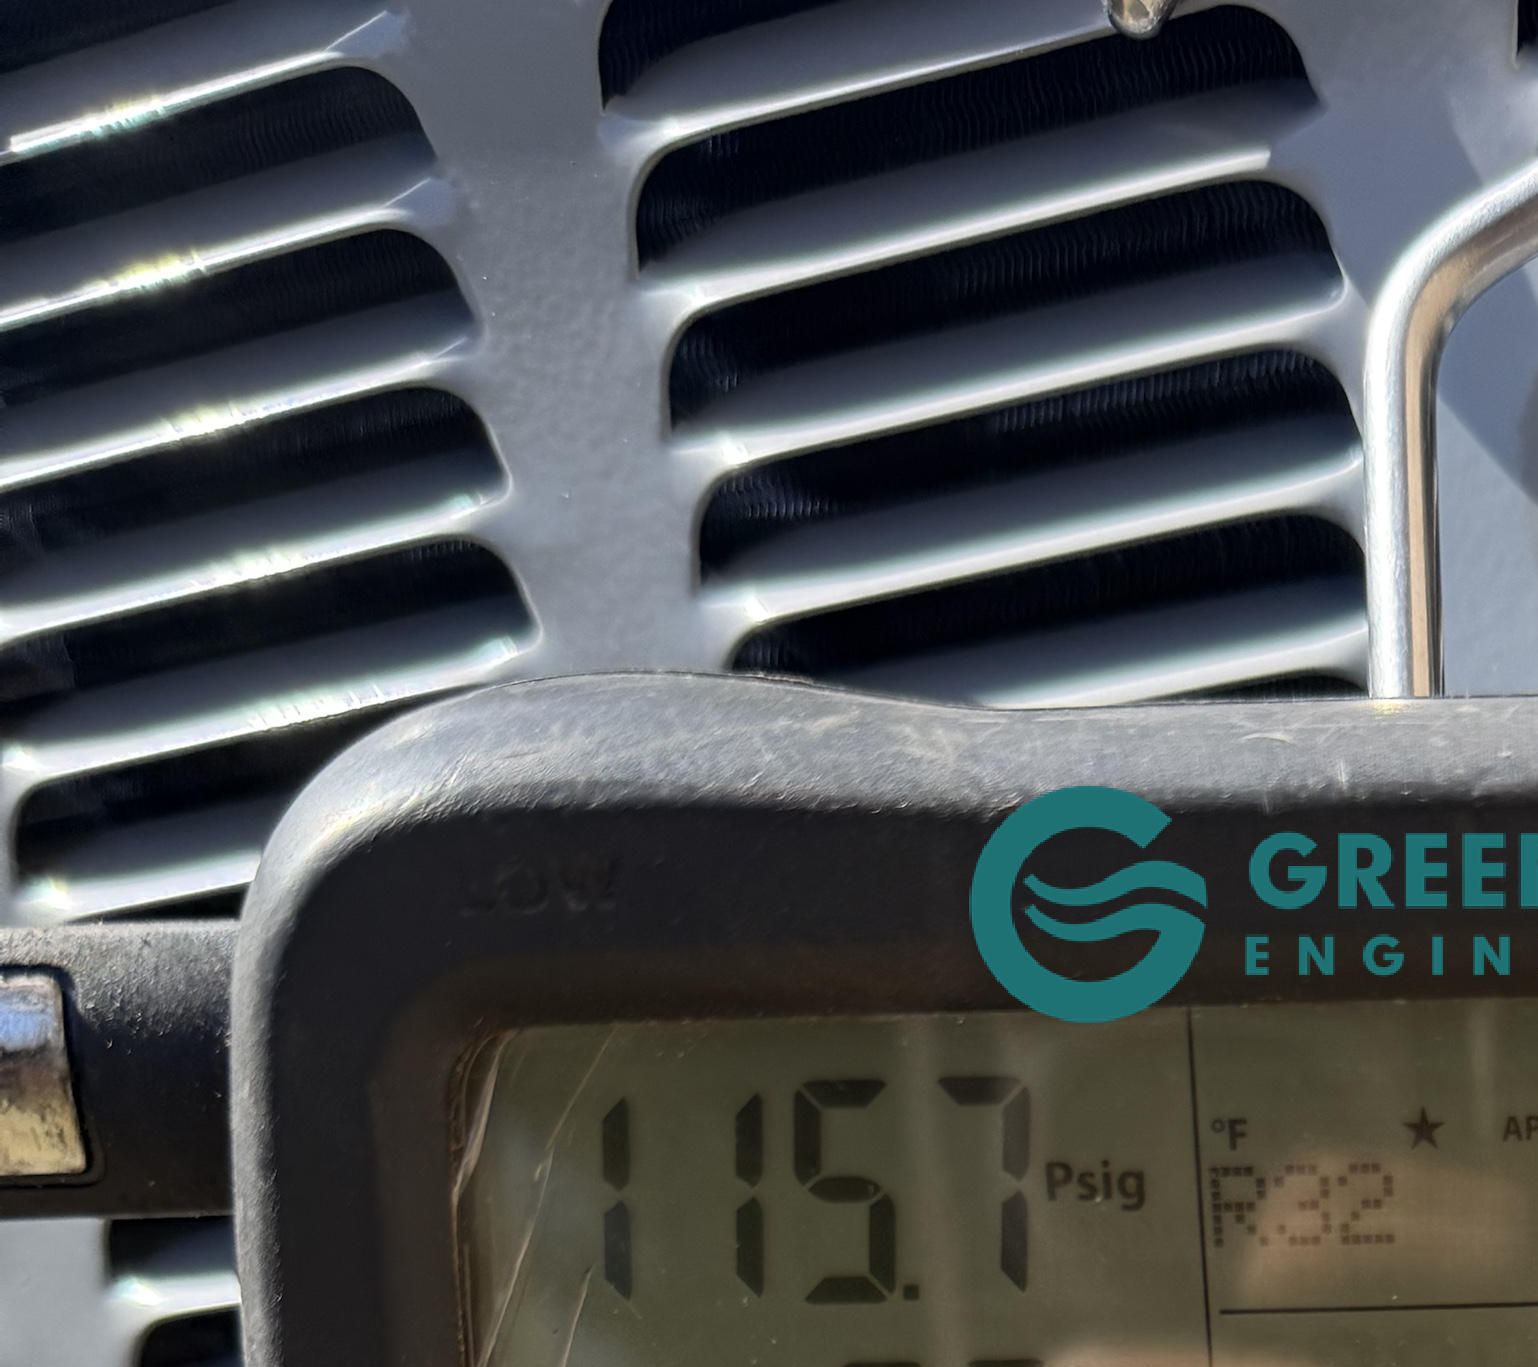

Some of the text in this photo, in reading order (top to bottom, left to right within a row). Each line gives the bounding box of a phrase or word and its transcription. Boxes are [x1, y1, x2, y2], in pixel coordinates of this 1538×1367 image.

[601, 1076, 1147, 1305] 115.7 Psig
[1209, 1163, 1395, 1248] R32
